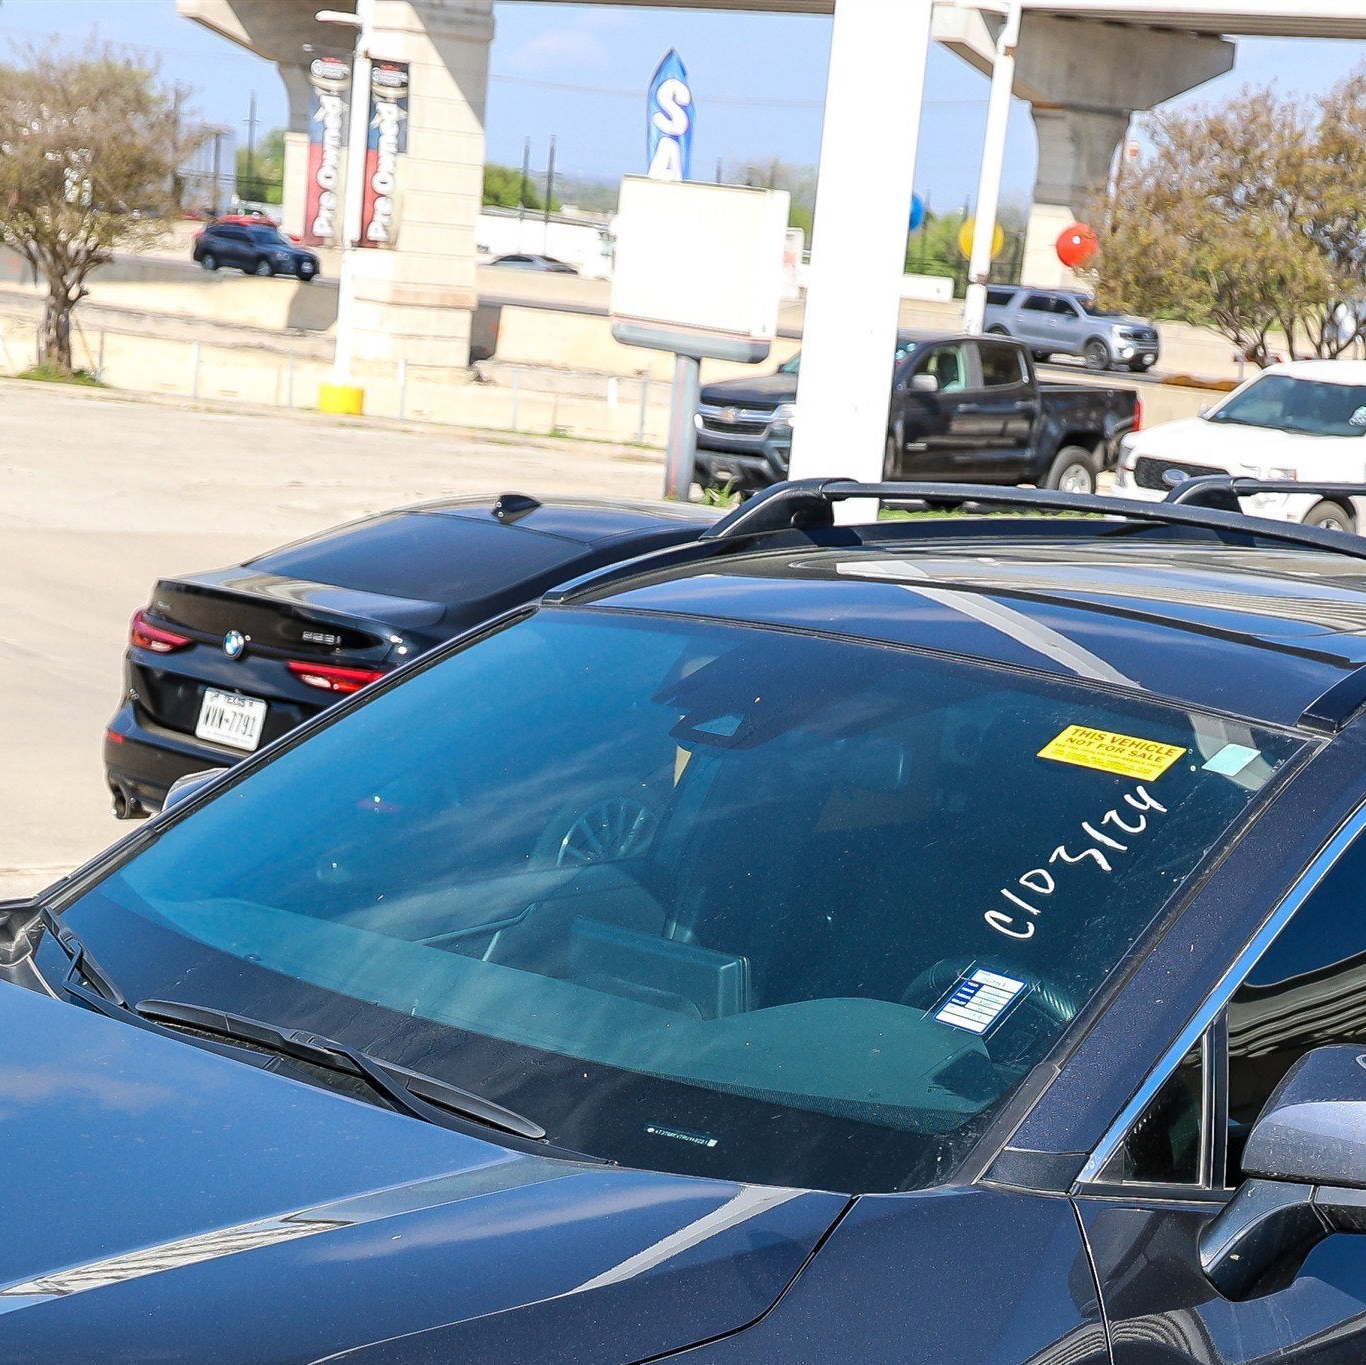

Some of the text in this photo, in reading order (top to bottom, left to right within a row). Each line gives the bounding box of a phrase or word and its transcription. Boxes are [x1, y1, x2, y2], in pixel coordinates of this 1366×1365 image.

[648, 78, 691, 182] SA
[1065, 736, 1093, 747] NOT
[1098, 742, 1127, 755] FOR
[1129, 750, 1167, 763] SALE
[1070, 728, 1178, 758] THIS VEHICLE
